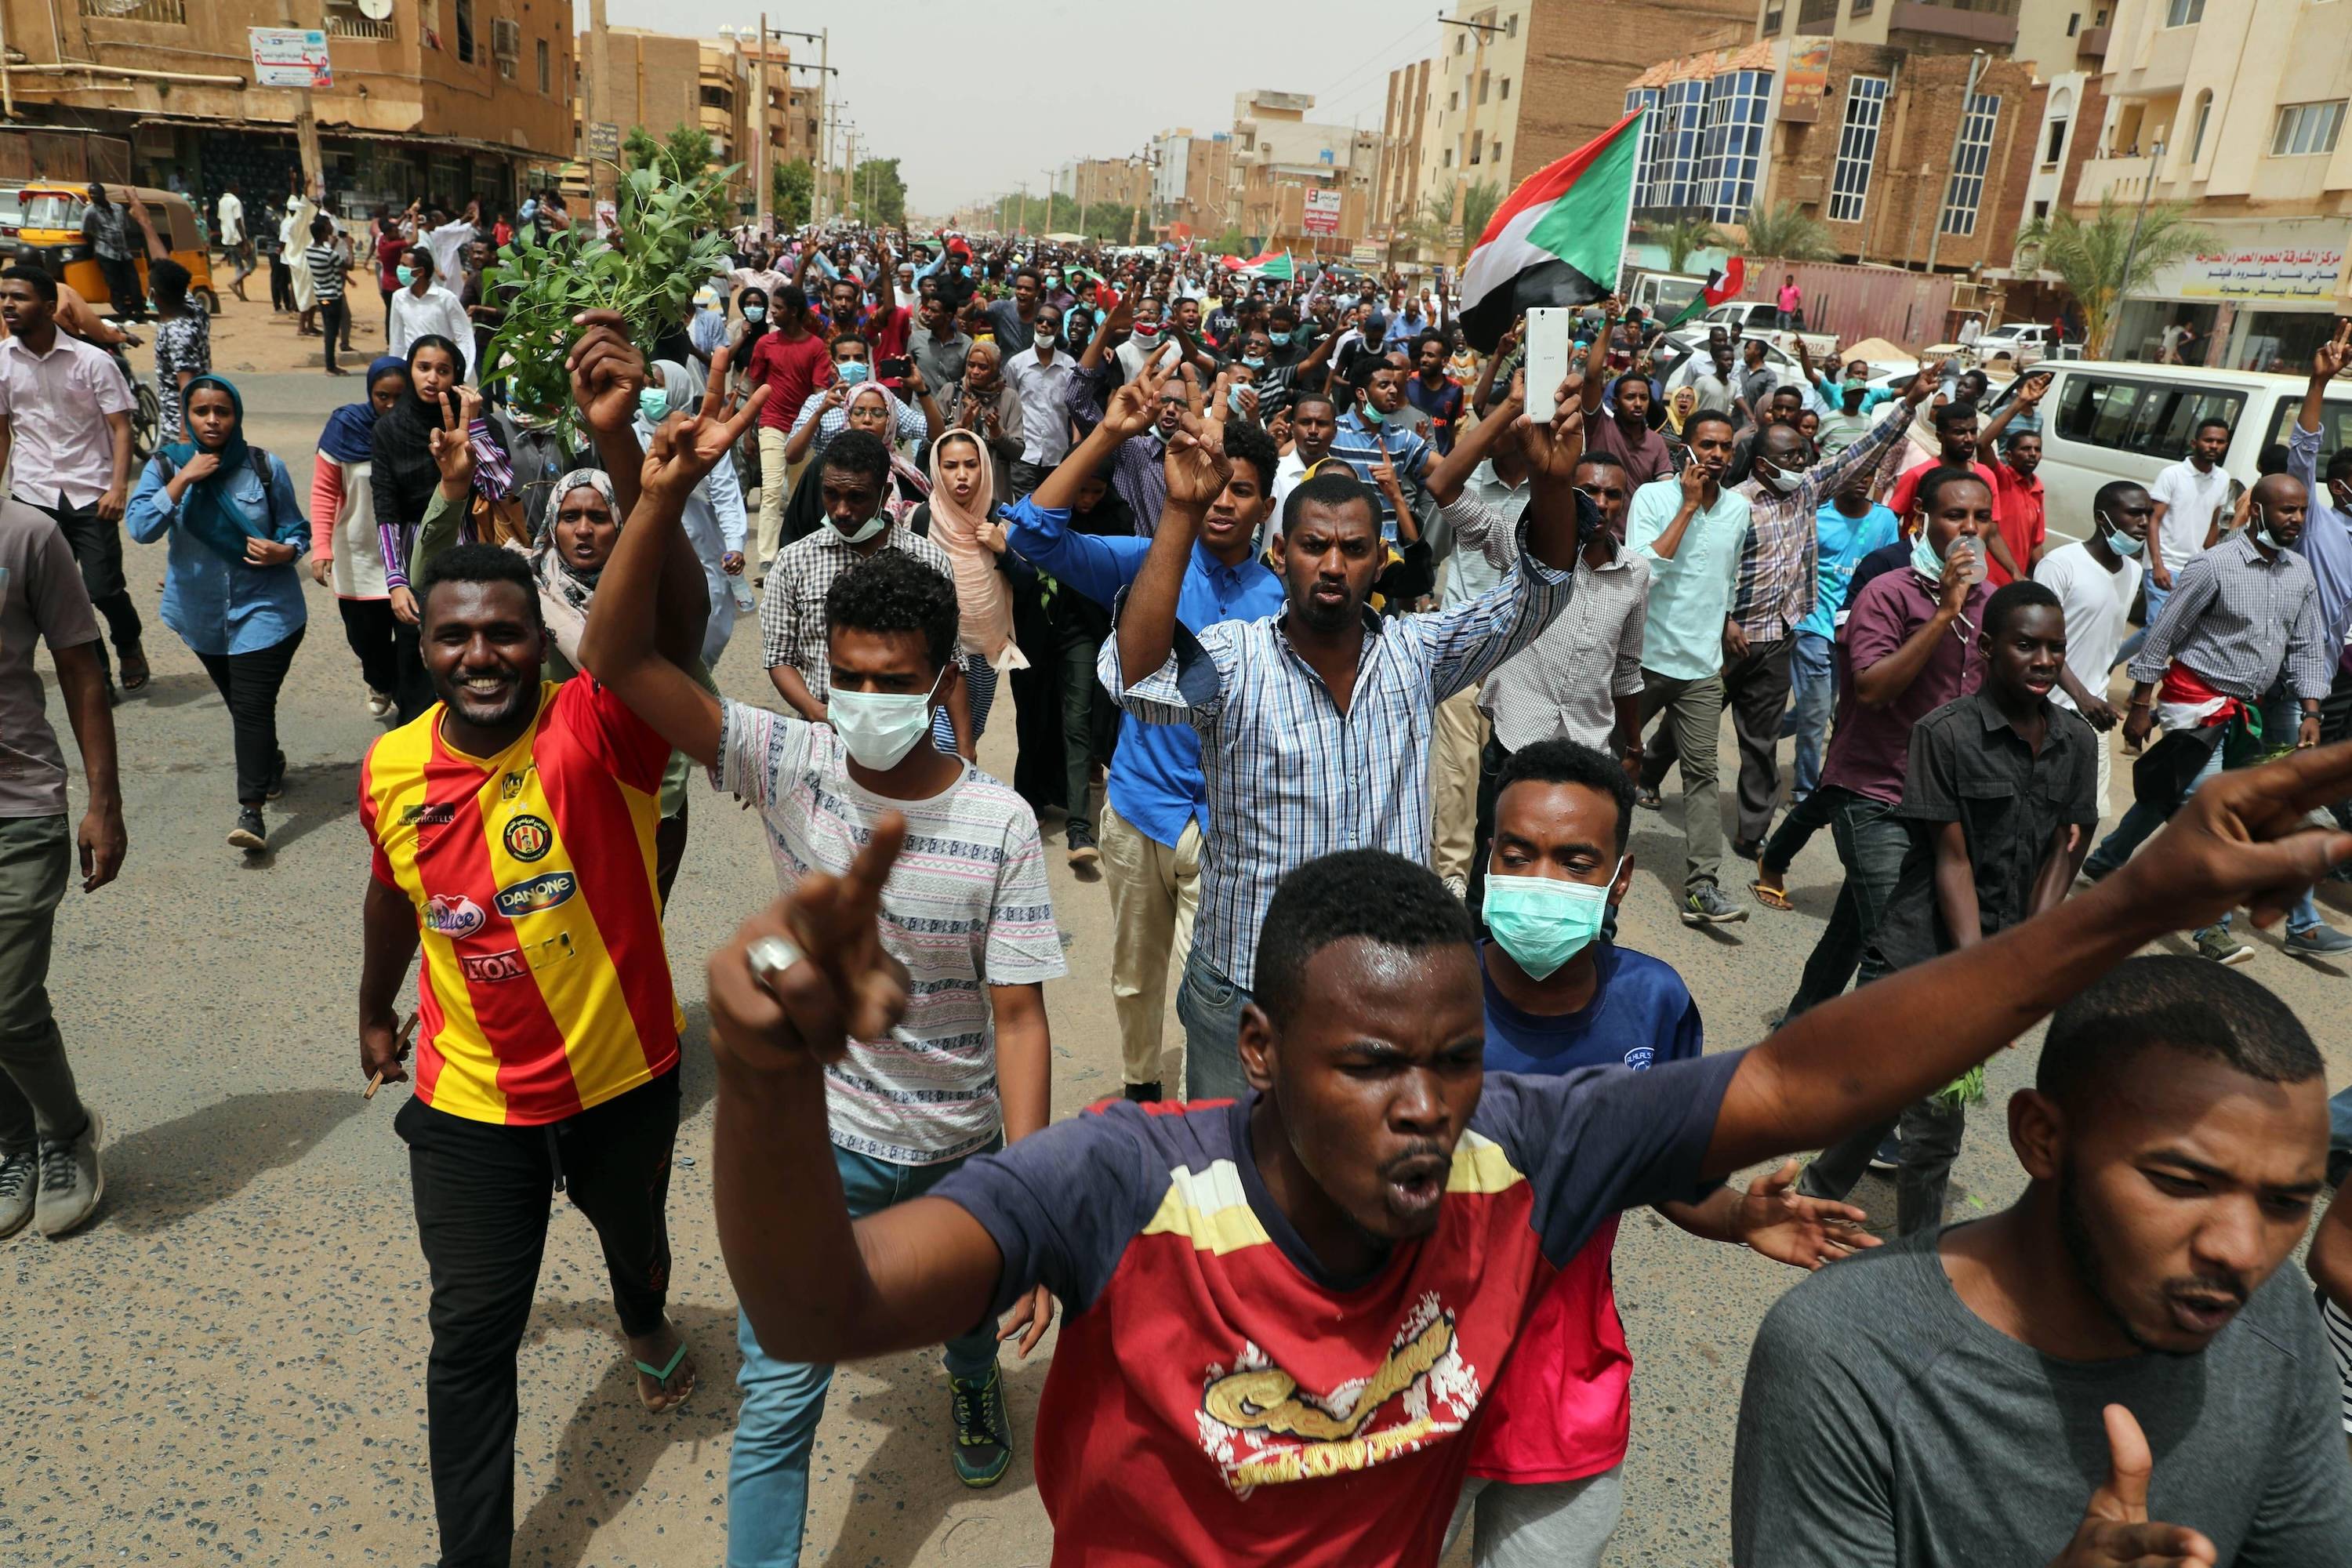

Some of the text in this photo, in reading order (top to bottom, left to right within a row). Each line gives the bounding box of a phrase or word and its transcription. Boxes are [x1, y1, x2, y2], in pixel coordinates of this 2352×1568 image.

[2229, 252, 2258, 266] الحمراء
[2258, 251, 2281, 266] للحوم
[2282, 249, 2318, 266] الشارقة
[2317, 250, 2341, 267] مركز
[420, 815, 455, 824] HOTELS
